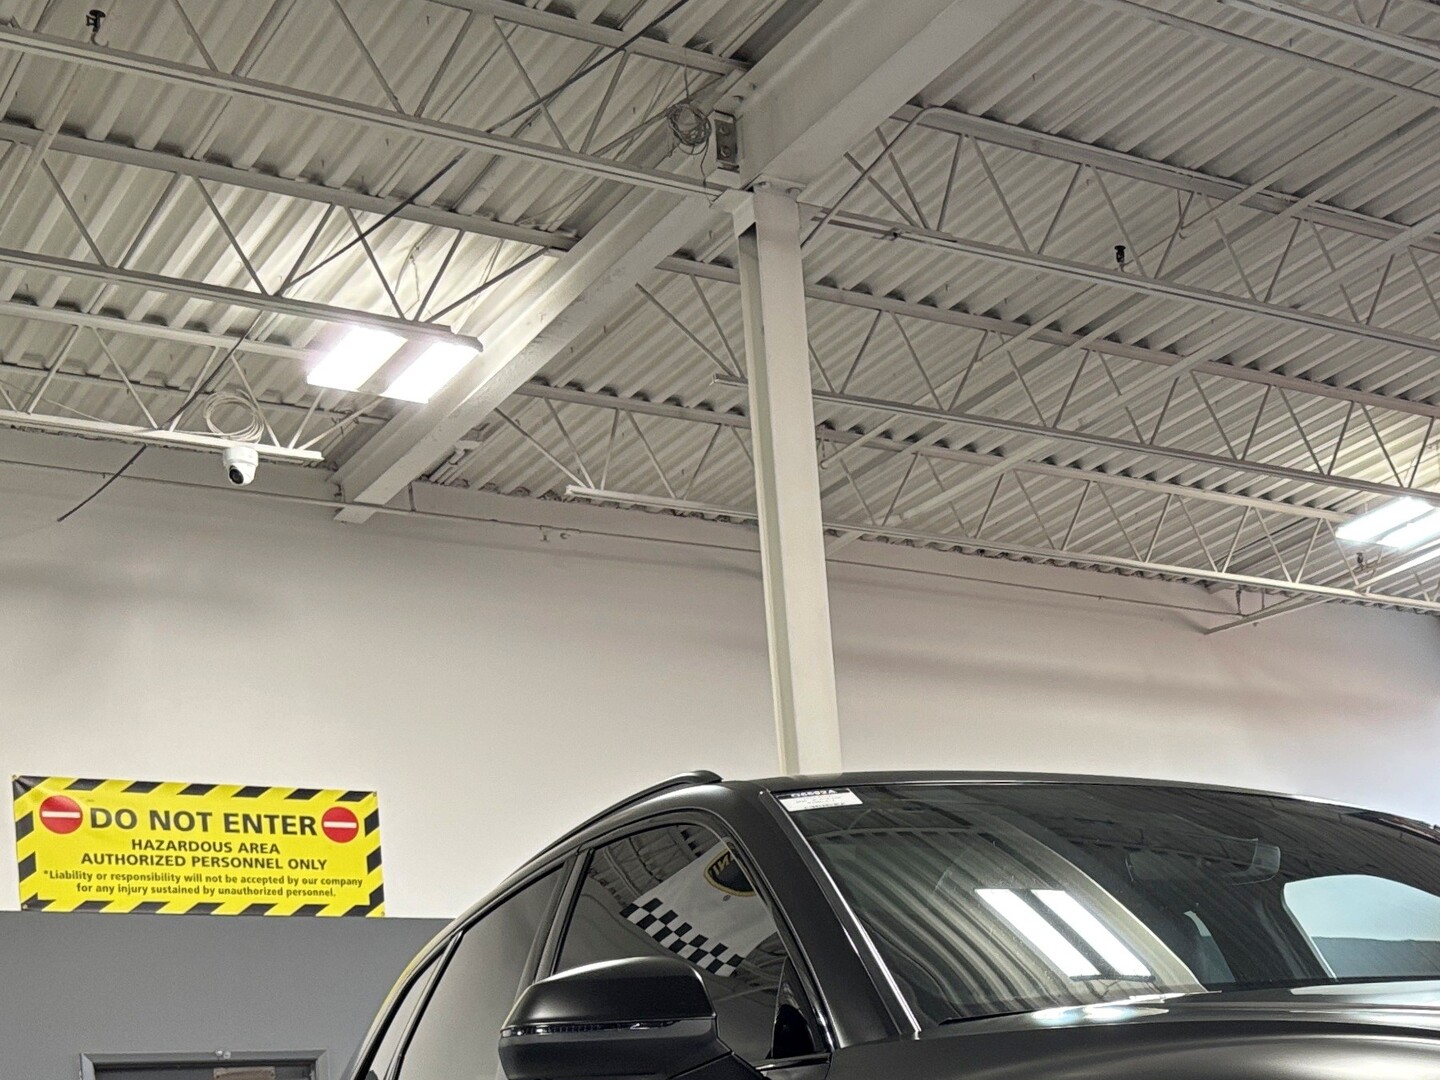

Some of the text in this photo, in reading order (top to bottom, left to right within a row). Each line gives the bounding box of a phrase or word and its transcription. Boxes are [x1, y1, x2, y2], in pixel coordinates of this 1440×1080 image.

[90, 807, 317, 836] DO NOT ENTER
[132, 839, 281, 855] HAZARDOUS AREA
[81, 853, 328, 871] AUTHORIZED PERSONNEL ONLY
[96, 872, 107, 882] or
[111, 872, 181, 884] responsibility
[184, 872, 203, 883] will
[204, 874, 222, 885] not
[225, 874, 239, 885] be
[241, 874, 285, 887] accepted
[287, 875, 299, 888] by
[301, 877, 319, 887] our
[321, 877, 363, 890] company
[77, 882, 337, 900] for any injury sustained by unauthorized personnel.
